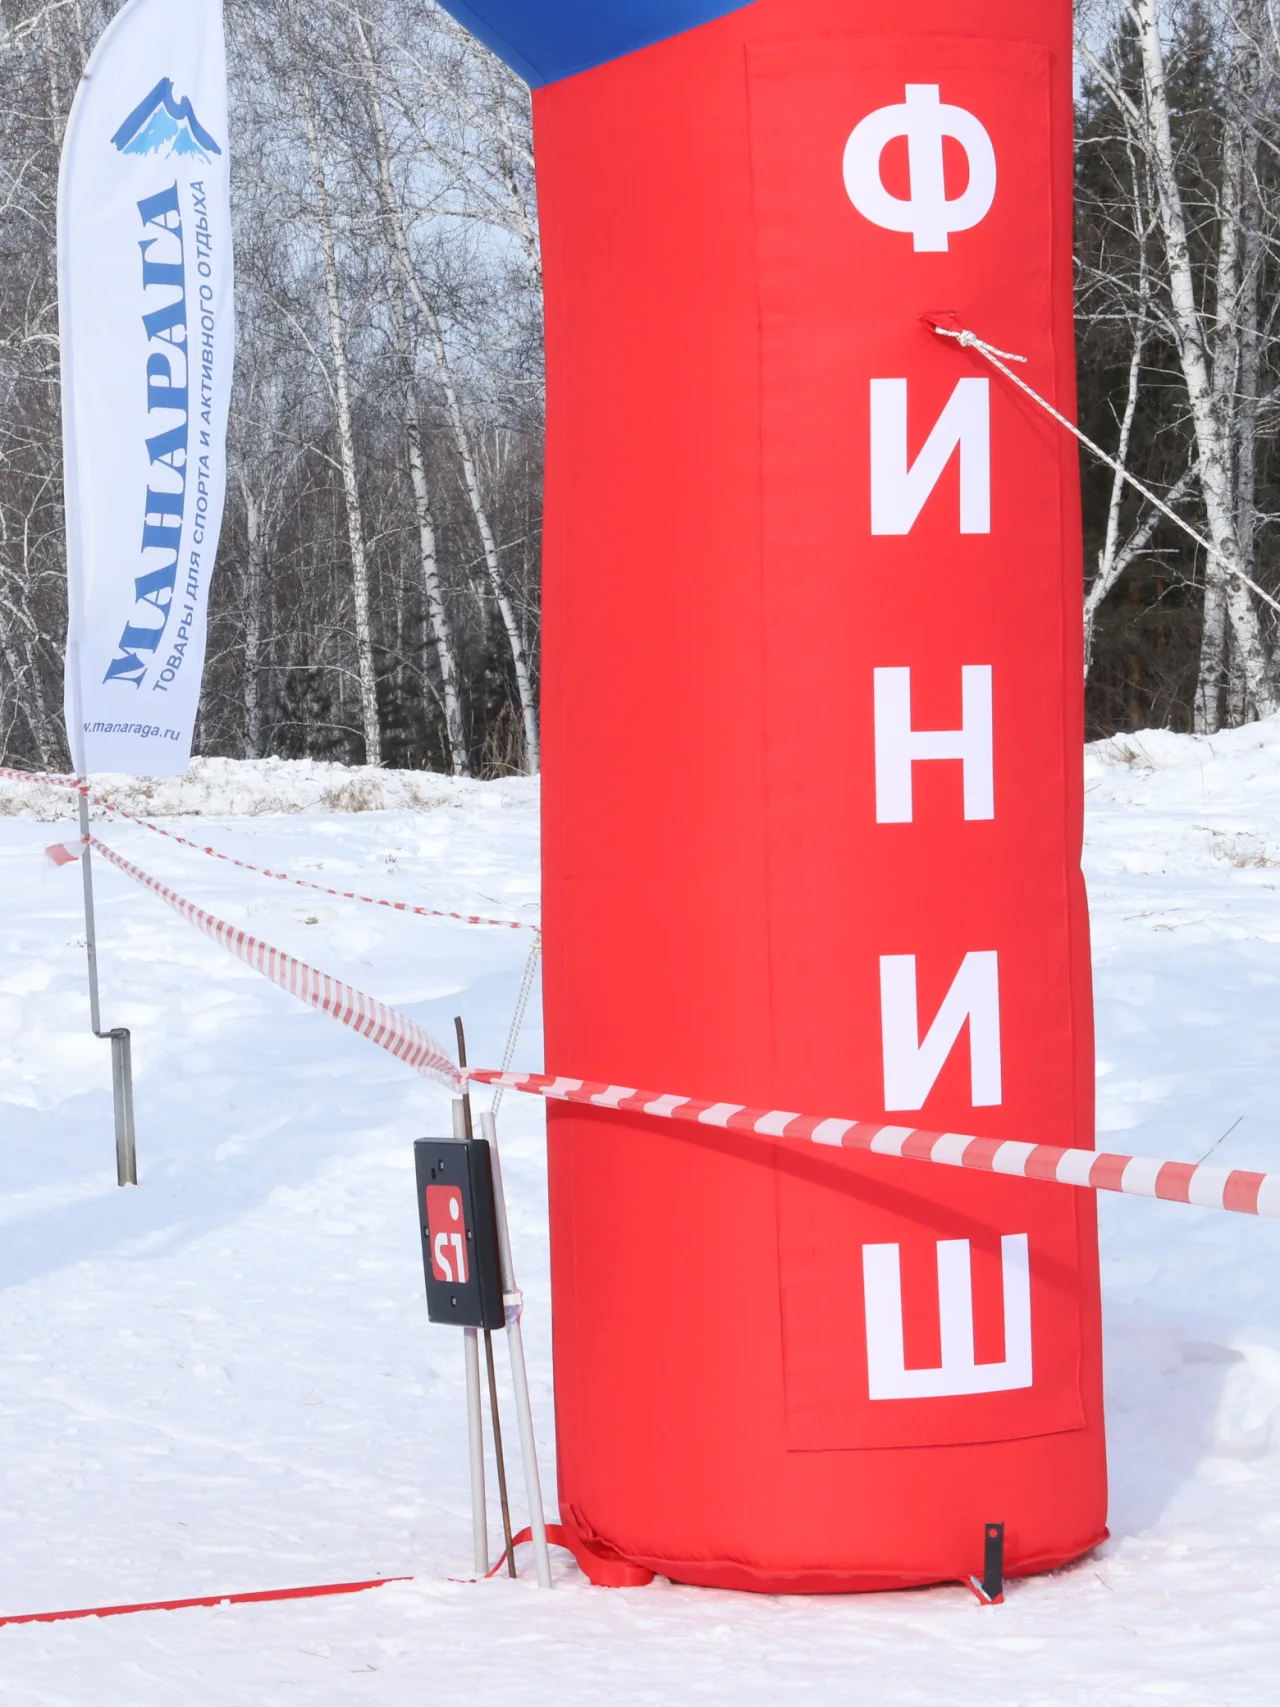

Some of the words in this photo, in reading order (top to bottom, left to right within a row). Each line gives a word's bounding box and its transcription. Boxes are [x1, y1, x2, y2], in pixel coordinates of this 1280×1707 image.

[189, 180, 213, 278] ОТДЫХА
[199, 284, 215, 426] АКТИВНОГО
[102, 178, 189, 690] МАНАРАГА
[199, 430, 210, 448] И
[193, 455, 210, 545] СПОРТА
[186, 550, 201, 602] ДЛЯ
[152, 604, 194, 692] ТОВАРЫ
[842, 83, 1035, 1400] ФИНИШ
